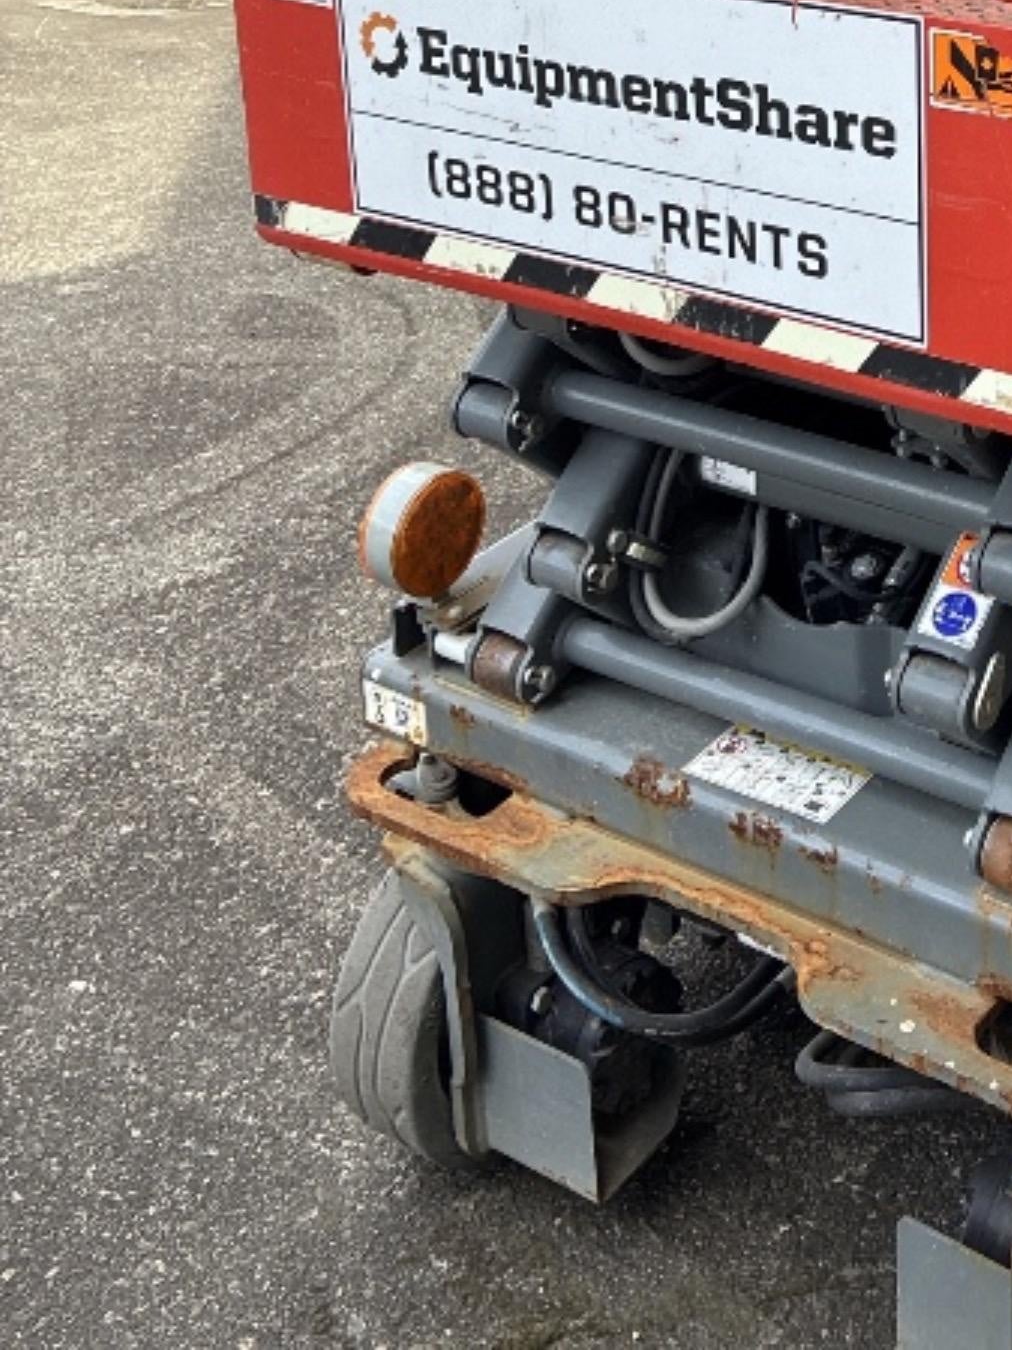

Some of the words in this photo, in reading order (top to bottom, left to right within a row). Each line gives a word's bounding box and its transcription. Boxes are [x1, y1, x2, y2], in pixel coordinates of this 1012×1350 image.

[416, 26, 898, 160] EquipmentShare
[426, 149, 555, 222] (888)
[574, 184, 831, 280] 80-RENTS
